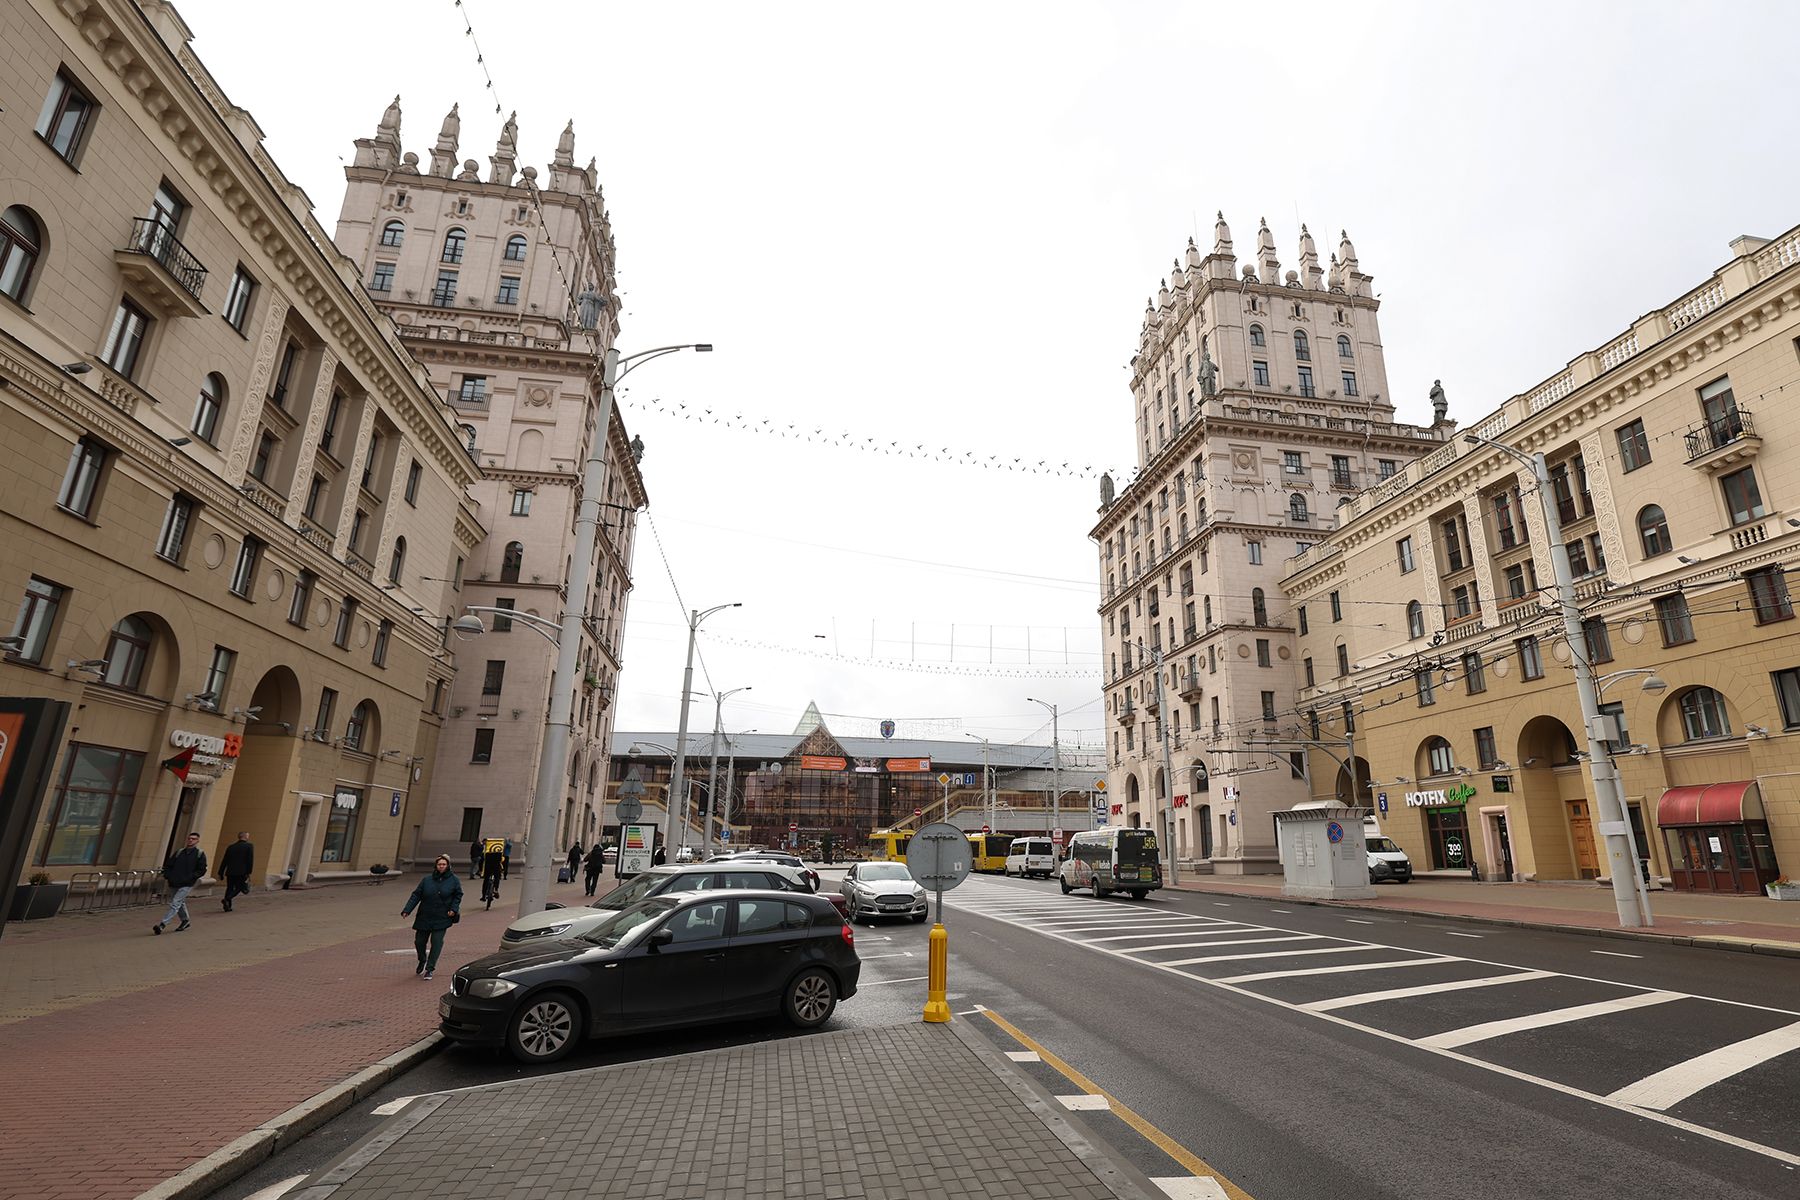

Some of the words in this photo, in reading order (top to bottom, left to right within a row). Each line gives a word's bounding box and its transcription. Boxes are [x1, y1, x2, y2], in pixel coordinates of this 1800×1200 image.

[171, 730, 225, 754] СОСЕДИ
[336, 793, 357, 809] ФОТО
[1174, 794, 1189, 808] KFC
[1405, 789, 1448, 807] HOTFIX
[1449, 783, 1476, 804] Coffee
[1111, 803, 1123, 816] KFC
[1380, 800, 1386, 810] 3
